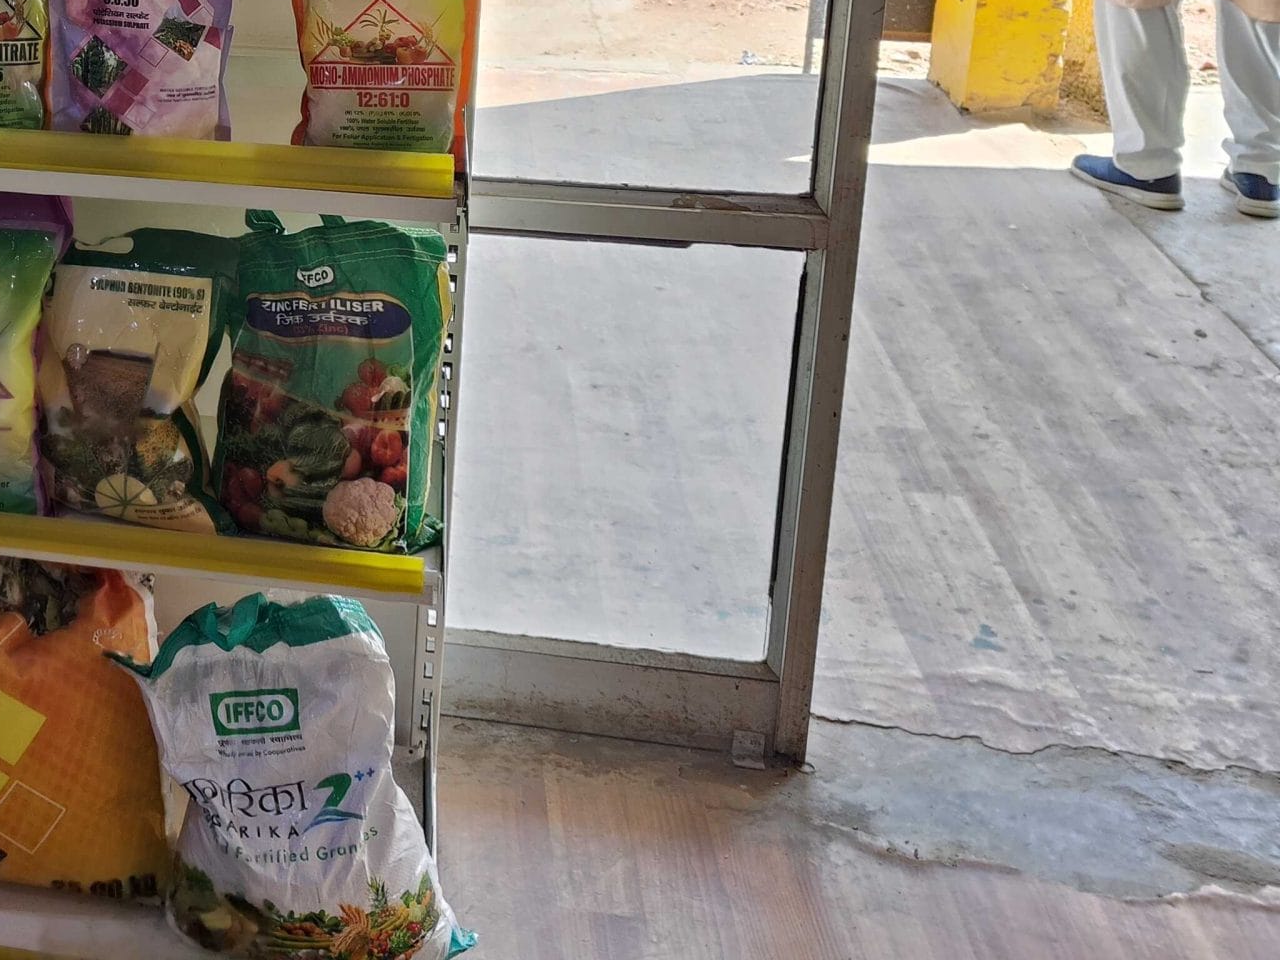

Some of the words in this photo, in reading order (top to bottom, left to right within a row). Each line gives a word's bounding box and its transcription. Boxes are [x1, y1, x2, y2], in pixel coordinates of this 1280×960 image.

[92, 19, 123, 28] POTASSIUM
[310, 65, 400, 87] MONO-AMMONIUM
[402, 66, 455, 88] PHOSPHATE
[356, 91, 410, 108] 12:61:0
[301, 269, 329, 284] FFCO
[293, 299, 385, 313] FERTILISER
[224, 699, 284, 724] IFFCO
